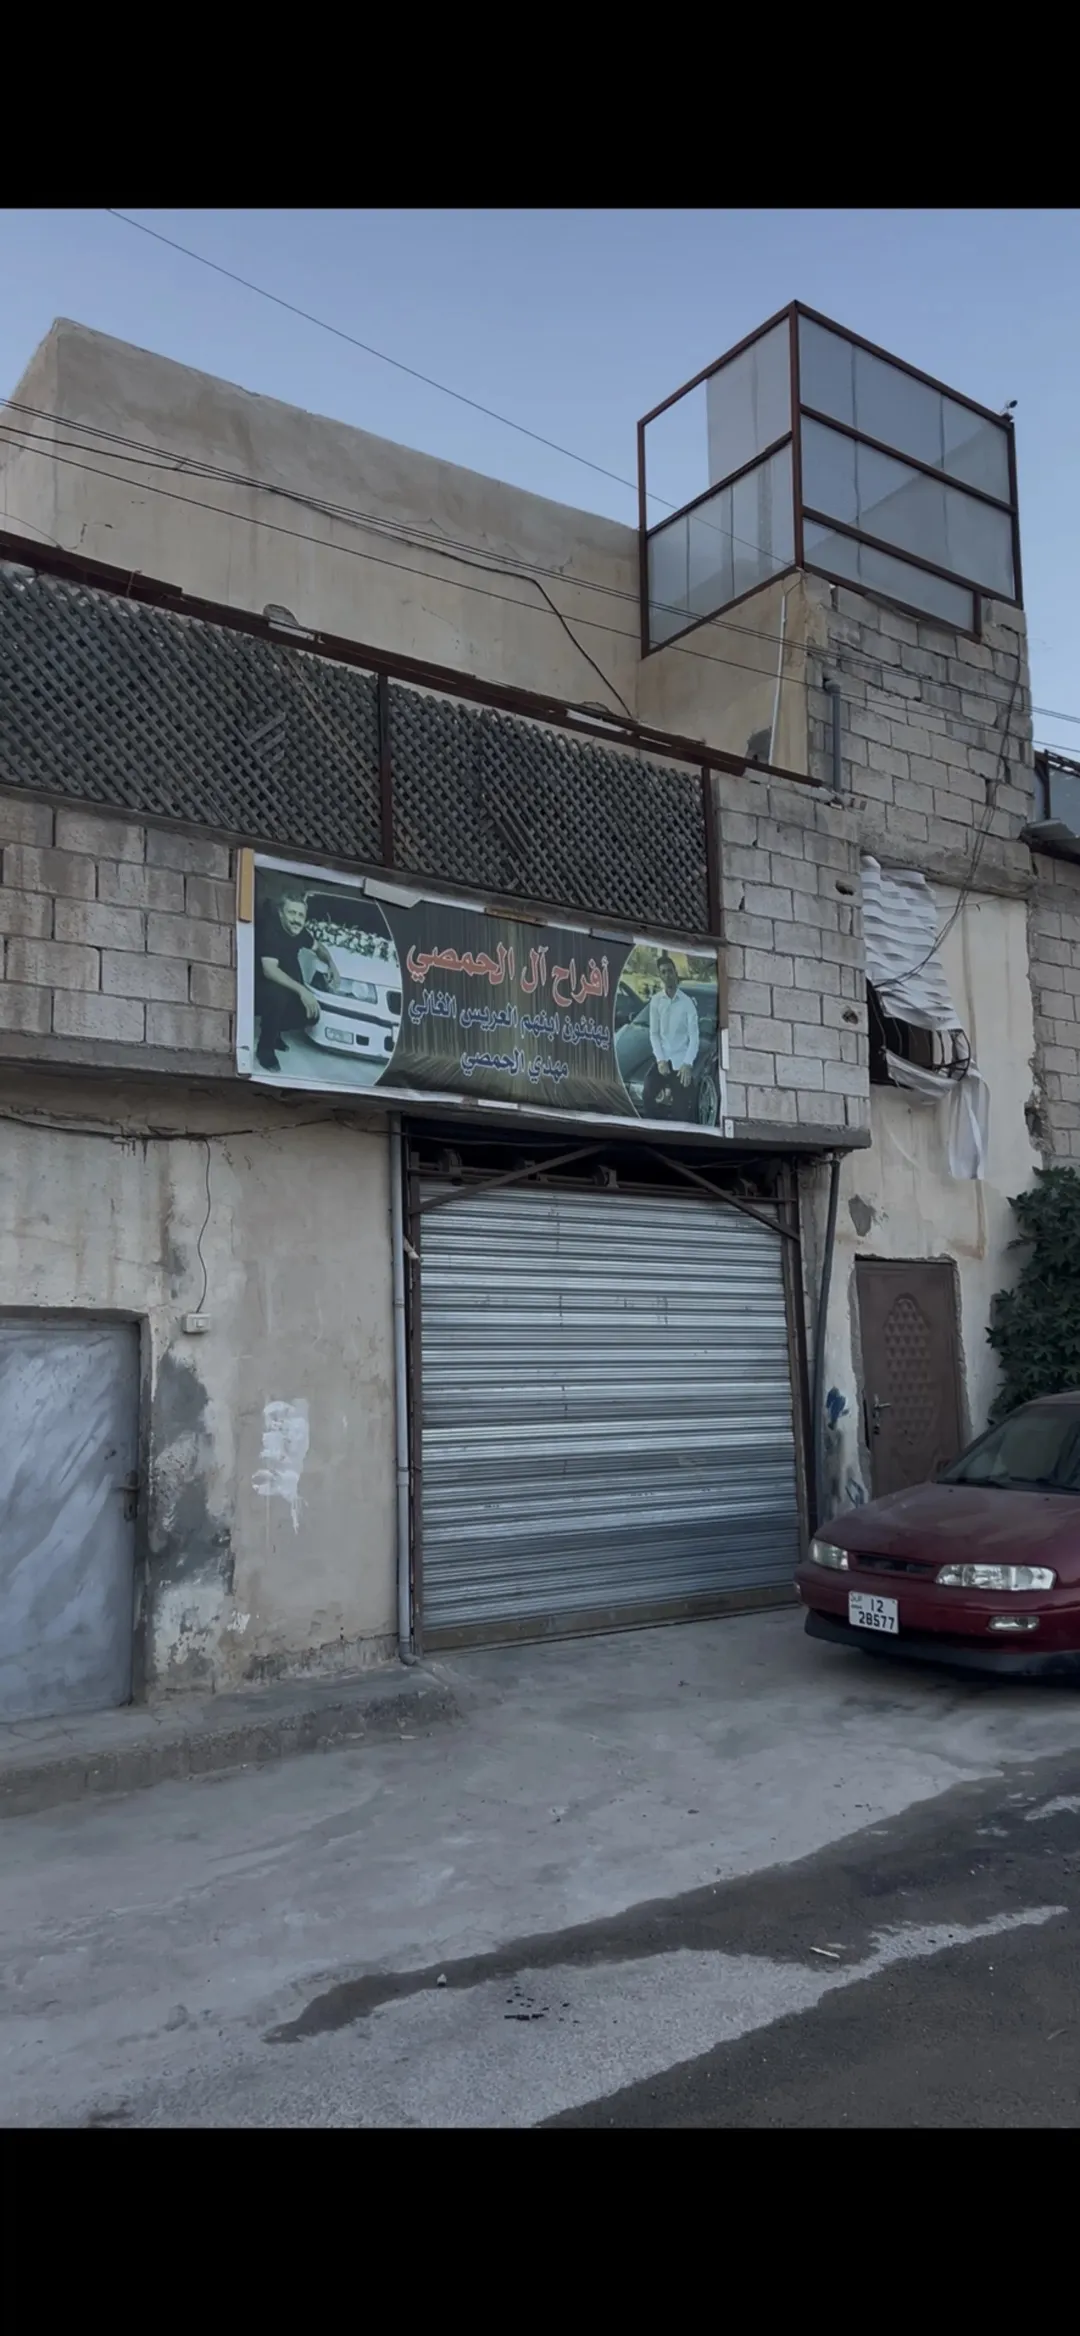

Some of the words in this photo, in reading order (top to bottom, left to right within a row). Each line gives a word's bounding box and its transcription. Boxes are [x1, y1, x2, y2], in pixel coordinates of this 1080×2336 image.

[406, 941, 516, 985] الحمصي
[521, 946, 549, 993] آل
[552, 956, 610, 1007] أفراح
[408, 988, 457, 1024] الغالي
[459, 1002, 518, 1032] العريس
[520, 1010, 560, 1041] ابنهم
[460, 1046, 525, 1076] الحمصي
[528, 1055, 569, 1083] مهدي
[858, 1611, 895, 1630] 28577
[870, 1598, 884, 1613] 12
